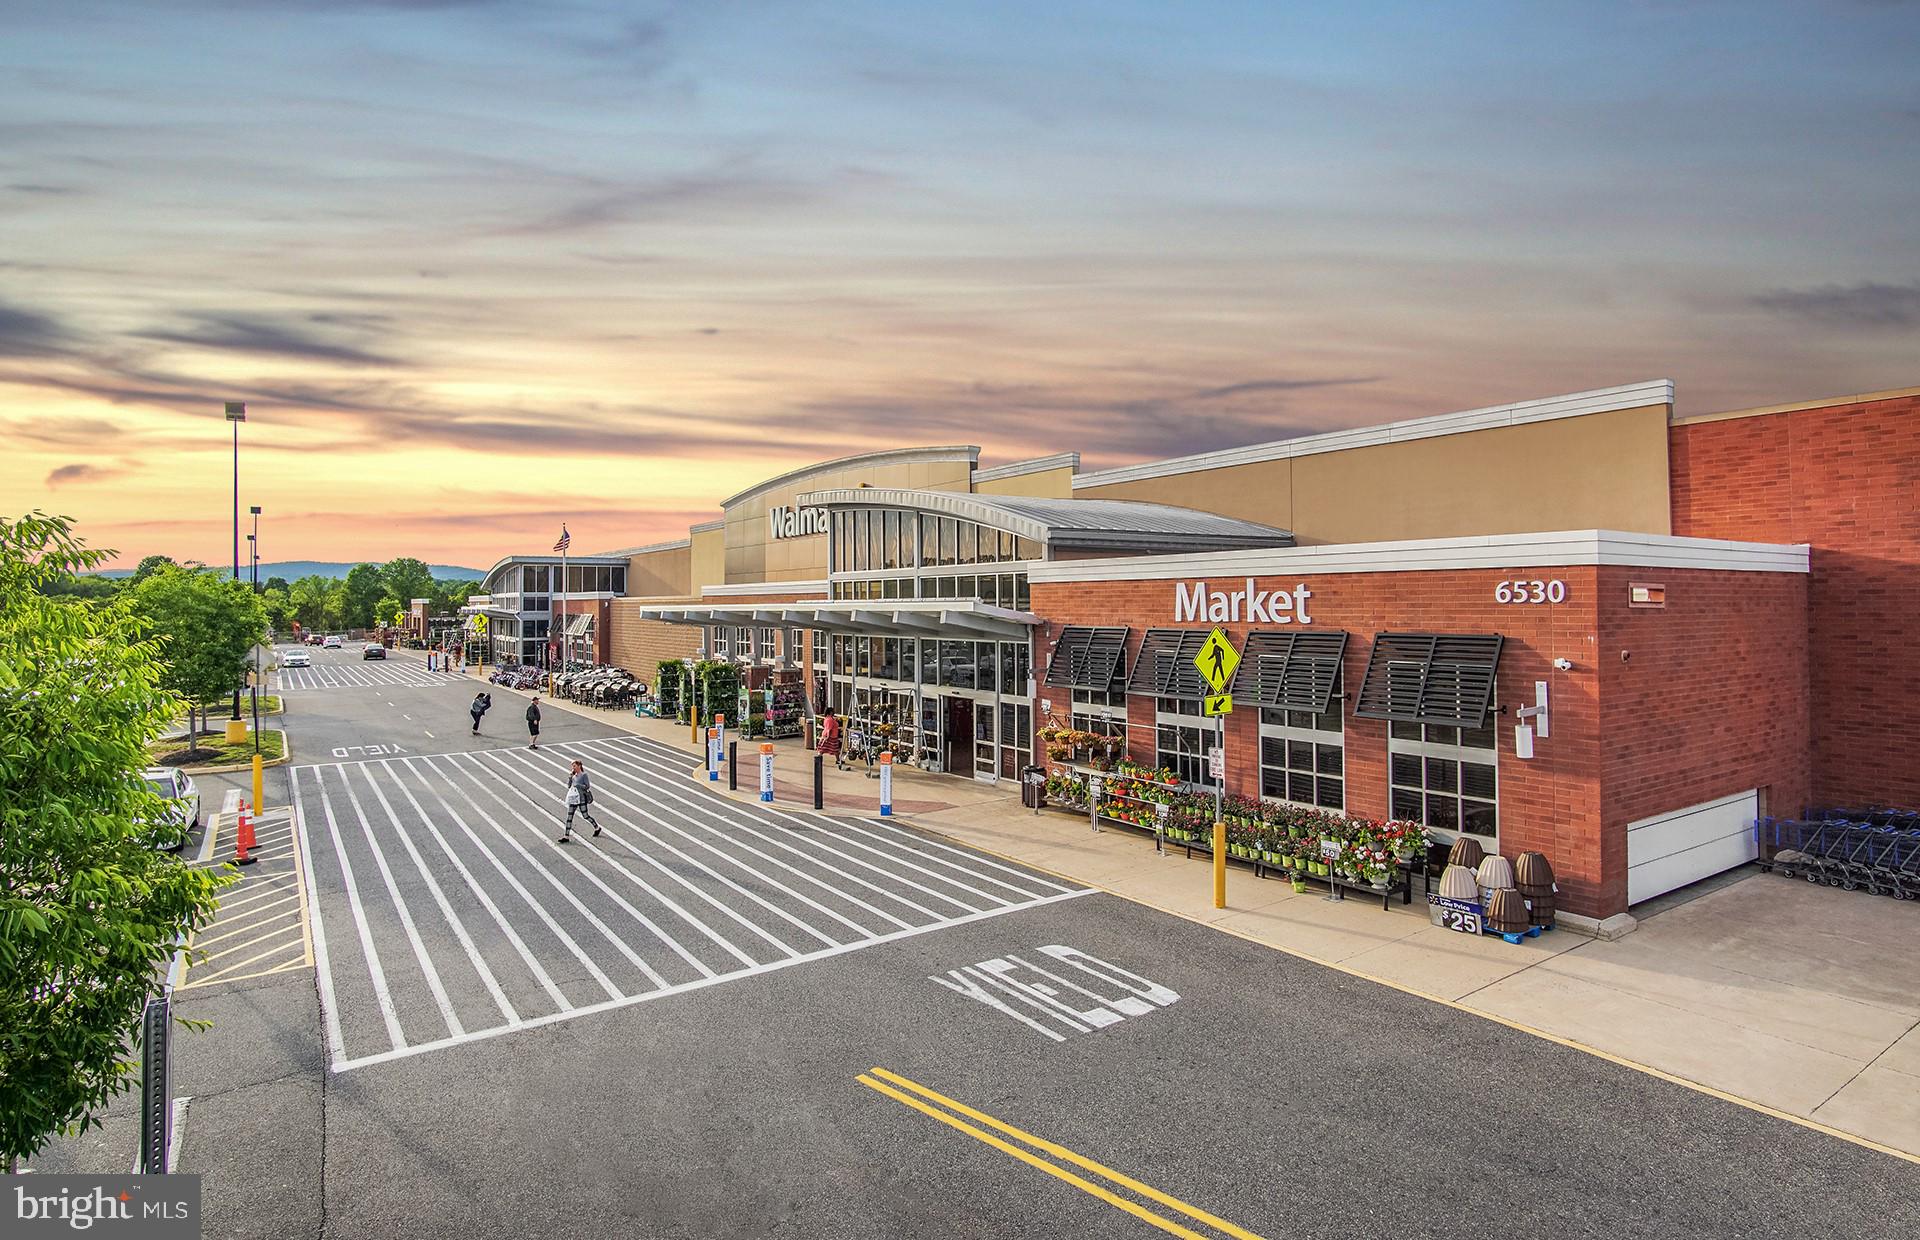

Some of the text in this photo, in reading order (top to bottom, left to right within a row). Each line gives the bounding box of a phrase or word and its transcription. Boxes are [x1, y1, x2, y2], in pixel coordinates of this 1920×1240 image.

[1175, 578, 1312, 624] Market
[1495, 580, 1565, 603] 6530
[331, 743, 408, 758] YIELD
[1440, 899, 1453, 908] Low
[1453, 902, 1471, 912] Price
[927, 944, 1181, 1042] YIELD
